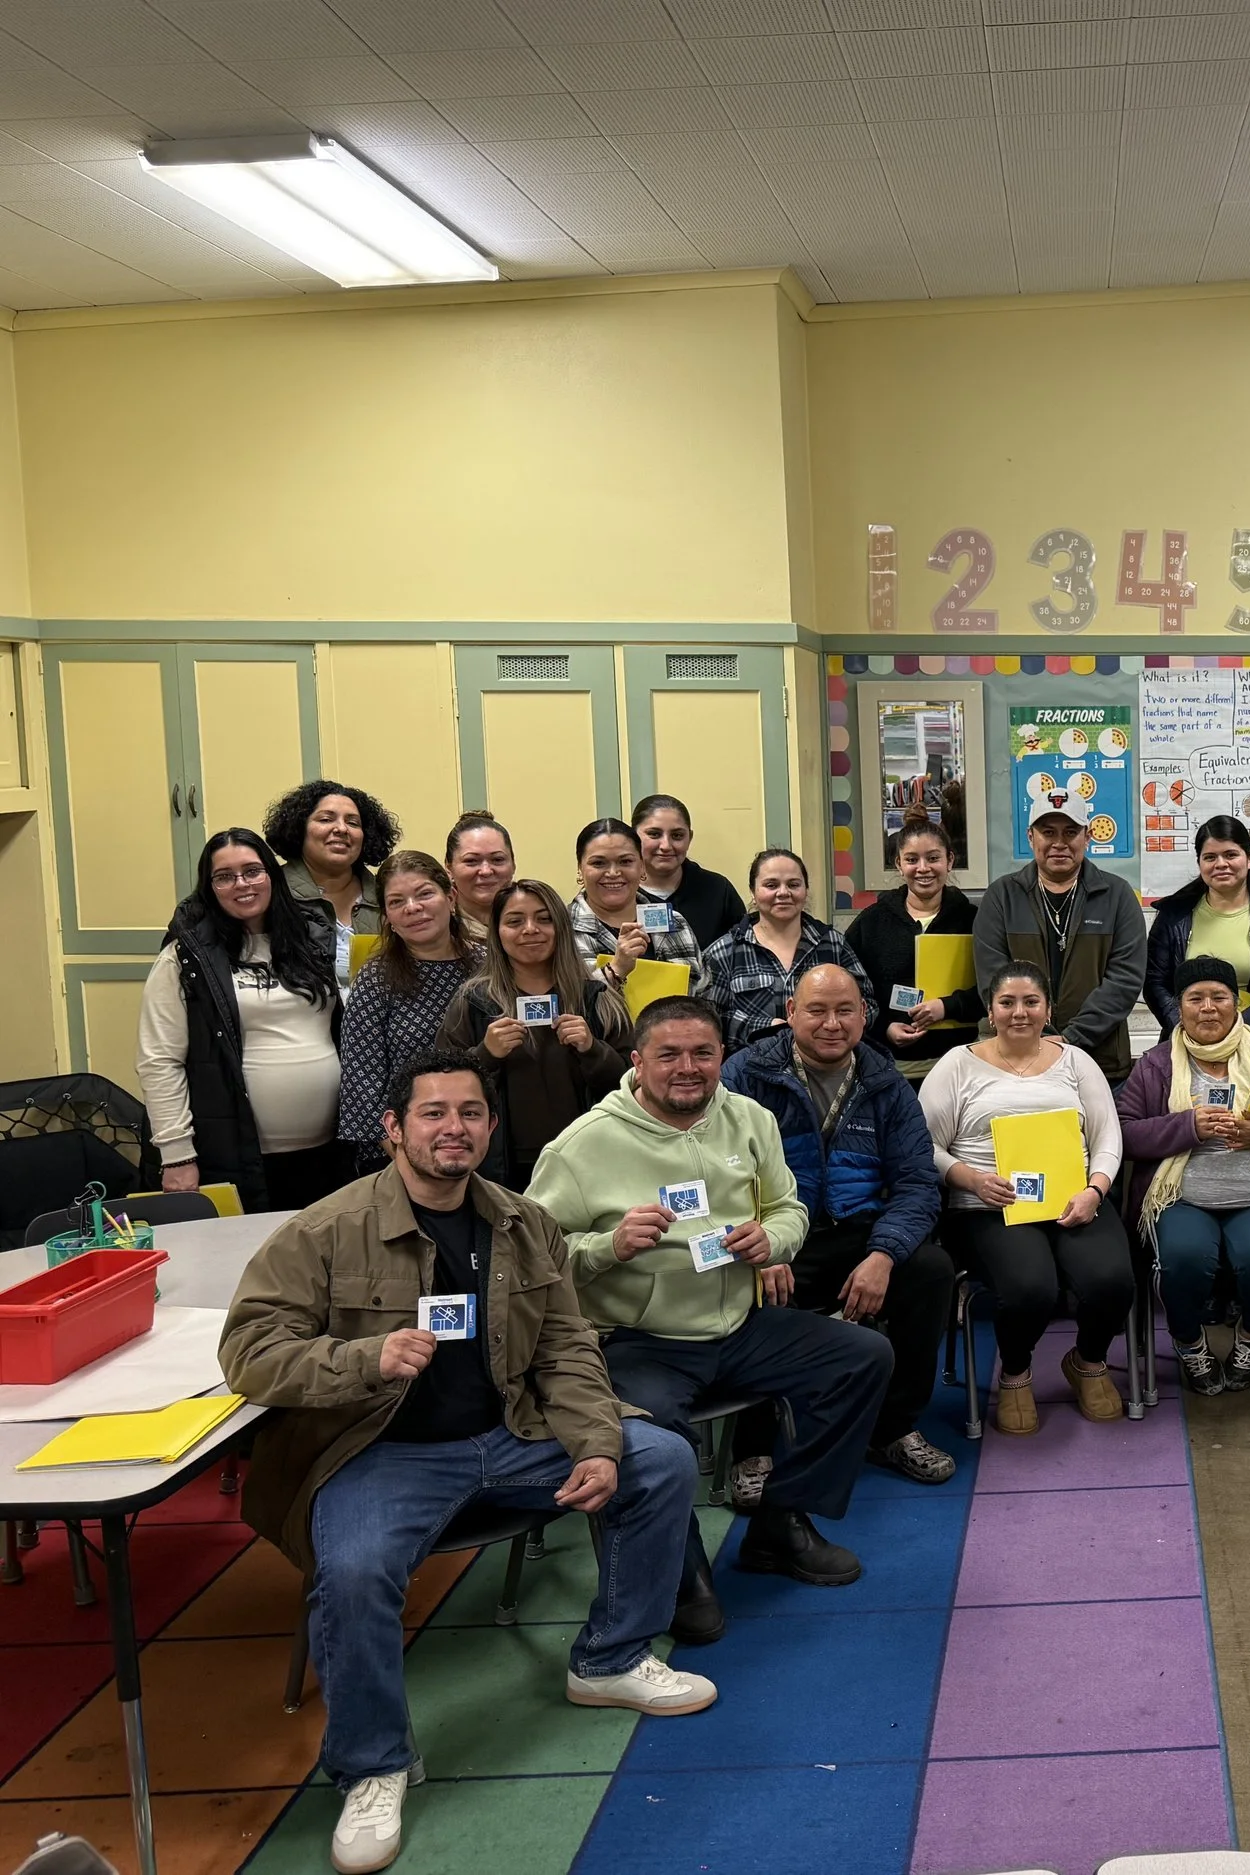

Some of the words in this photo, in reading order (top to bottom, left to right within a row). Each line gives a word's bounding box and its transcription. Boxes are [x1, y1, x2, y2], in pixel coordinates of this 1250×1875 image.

[957, 536, 962, 544] 6
[969, 536, 975, 544] 8
[1071, 538, 1079, 546] 12
[1130, 539, 1135, 547] 4
[1170, 541, 1180, 549] 32
[978, 547, 987, 556] 10
[1080, 551, 1088, 559] 15
[1129, 555, 1134, 563] 8
[1169, 557, 1180, 565] 36
[977, 564, 985, 573] 12
[1076, 565, 1084, 573] 18
[1125, 571, 1134, 579] 12
[927, 528, 998, 632] 2
[1028, 528, 1097, 634] 3
[1116, 530, 1197, 634] 4
[958, 590, 967, 598] 16
[1078, 587, 1088, 595] 24
[1124, 587, 1133, 595] 16
[1141, 588, 1152, 596] 20
[1160, 588, 1171, 597] 24
[1179, 589, 1190, 598] 28
[1080, 602, 1090, 611] 27
[1167, 602, 1177, 611] 44
[1039, 607, 1050, 615] 36
[943, 618, 953, 626] 20
[960, 618, 970, 626] 22
[977, 618, 987, 626] 24
[1051, 617, 1062, 625] 33
[1069, 616, 1080, 624] 30
[1167, 618, 1177, 626] 48
[1142, 671, 1172, 682] What
[1178, 673, 1186, 682] is
[1192, 670, 1209, 682] it?
[1241, 695, 1248, 704] I
[1143, 706, 1174, 717] fractions
[1178, 706, 1193, 717] that
[1036, 709, 1105, 723] FRACTIONS
[1145, 720, 1156, 731] the
[1160, 723, 1178, 731] same
[1182, 720, 1201, 733] part
[1204, 719, 1213, 730] of
[1149, 735, 1175, 743] whole
[1143, 761, 1185, 776] Examples:
